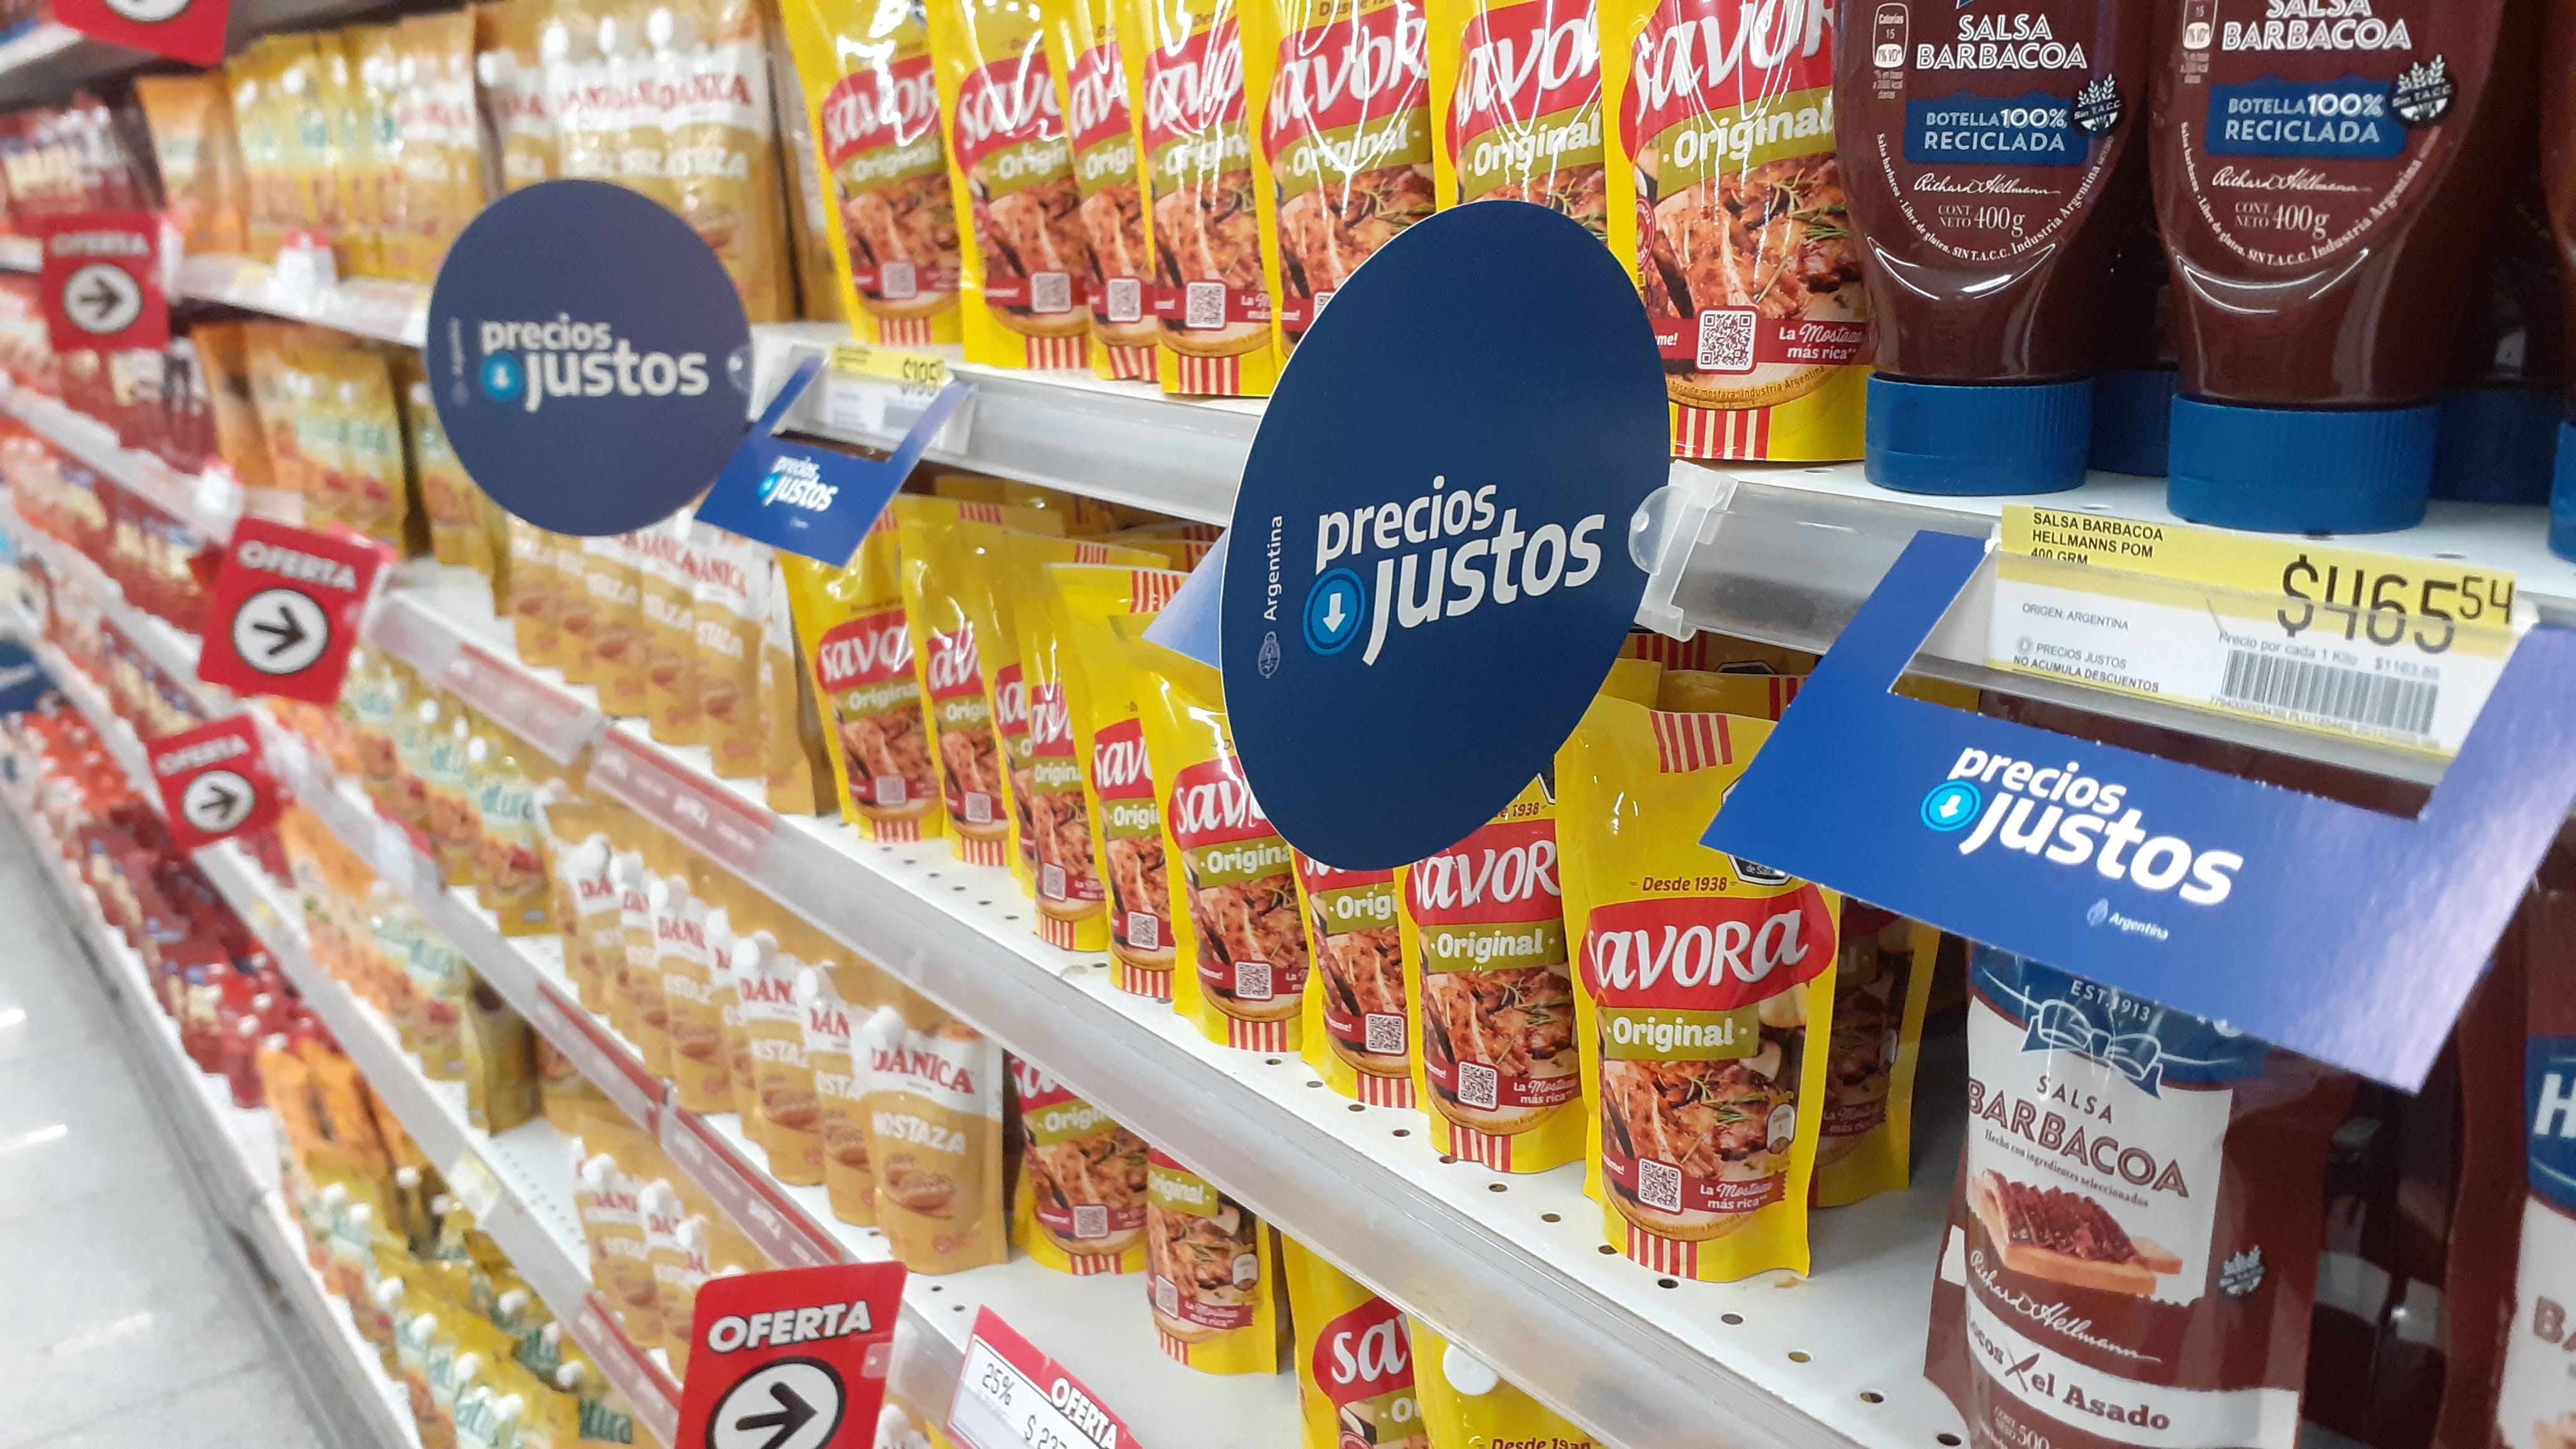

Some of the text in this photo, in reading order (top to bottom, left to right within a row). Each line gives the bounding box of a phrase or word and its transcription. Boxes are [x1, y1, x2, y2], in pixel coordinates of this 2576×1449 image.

[2266, 0, 2372, 19] SALSA
[1886, 28, 1895, 40] 15
[1958, 13, 2053, 42] SALSA
[2222, 18, 2412, 51] BARBACOA
[1916, 42, 2089, 70] BARBACOA
[1926, 107, 2068, 129] BOTELLA 100%
[2227, 92, 2384, 117] BOTELLA 100%
[1473, 112, 1601, 177] Original
[1674, 90, 1834, 168] Original
[1924, 132, 2066, 152] RECICLADA
[2225, 119, 2381, 144] RECICLADA
[1901, 201, 1918, 226] Libre
[1916, 222, 1926, 234] de
[1951, 246, 1969, 260] SIN
[2011, 217, 2063, 255] Industria
[2059, 165, 2102, 218] Argentina
[1939, 217, 1972, 228] NETO
[2235, 215, 2270, 228] NETO
[2311, 218, 2373, 260] Industria
[480, 312, 612, 356] precios
[1654, 332, 1679, 346] me!
[1779, 327, 1795, 341] La
[1787, 344, 1818, 359] más
[524, 338, 710, 412] justos
[1785, 364, 1826, 391] Argentina
[764, 476, 839, 512] justos
[1315, 475, 1498, 575] precios
[2033, 512, 2164, 542] SALSA BARBACOA
[2031, 547, 2088, 565] 400 GRM
[2032, 529, 2154, 558] HELLMANNS POM
[237, 540, 357, 591] OFERTA
[1264, 515, 1284, 622] Argentina
[1362, 508, 1606, 666] justos
[2276, 553, 2514, 655] $465 54
[2067, 611, 2129, 631] ARGENTINA
[2036, 642, 2127, 670] PRECIOS JUSTOS
[2261, 640, 2281, 652] por
[2013, 655, 2160, 693] NO ACUMULA DESCUENTOS
[1948, 747, 2127, 815] precios
[1512, 802, 1540, 817] 1938
[1958, 791, 2245, 906] justos
[1642, 876, 1729, 892] Desde 1938
[2108, 911, 2170, 942] Argentina
[1436, 928, 1543, 964] Original
[2071, 979, 2151, 1022] EST. 1913
[1612, 1017, 1734, 1053] Original
[1513, 1081, 1527, 1093] La
[1520, 1091, 1544, 1104] más
[2037, 1075, 2113, 1125] SALSA
[1968, 1078, 2190, 1199] BARBACOA
[1984, 1128, 2149, 1208] Hecho con ingredientes seleccionados
[1700, 1184, 1714, 1196] La
[1708, 1196, 1734, 1209] más
[707, 1300, 873, 1354] OFERTA
[1330, 1312, 1410, 1385] SA
[981, 1362, 1016, 1407] 25%
[1051, 1377, 1118, 1449] OFERTA
[2031, 1371, 2171, 1432] el Asado
